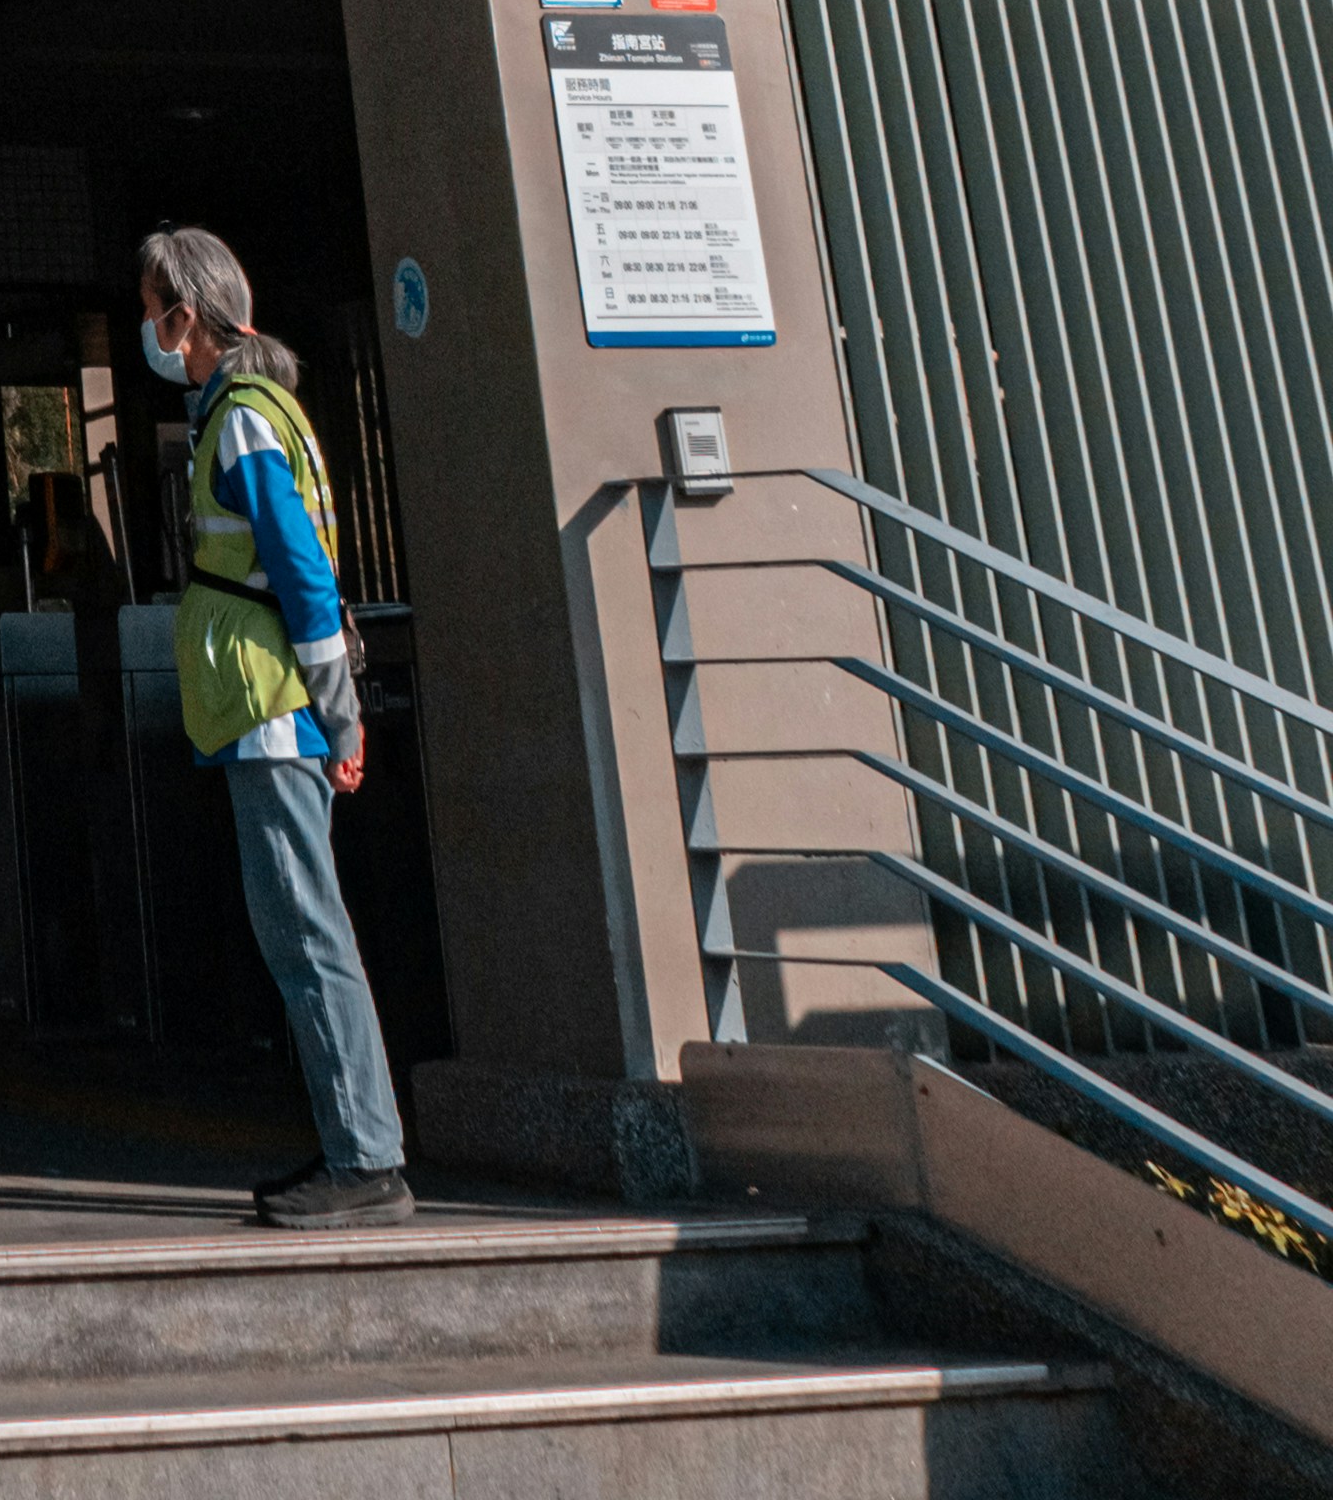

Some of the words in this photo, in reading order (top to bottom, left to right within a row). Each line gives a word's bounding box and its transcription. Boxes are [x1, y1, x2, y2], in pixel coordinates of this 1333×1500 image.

[611, 33, 666, 51] 指南宮站
[655, 53, 684, 64] Station
